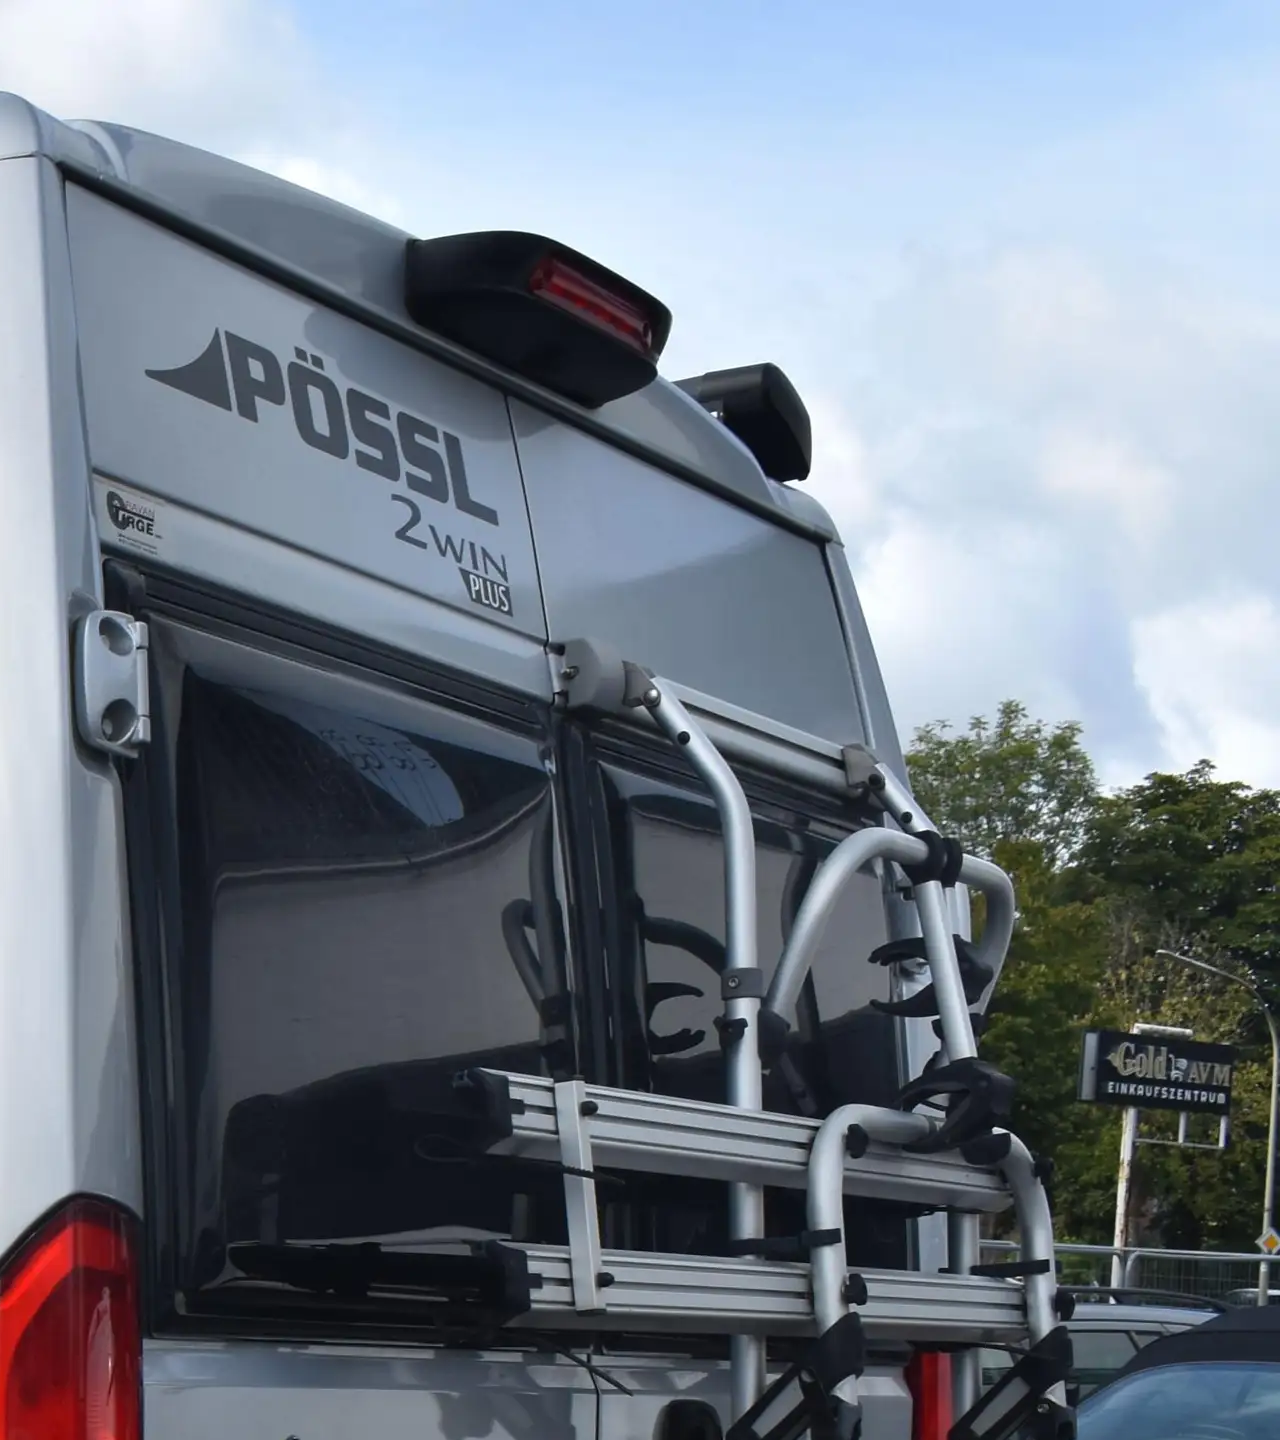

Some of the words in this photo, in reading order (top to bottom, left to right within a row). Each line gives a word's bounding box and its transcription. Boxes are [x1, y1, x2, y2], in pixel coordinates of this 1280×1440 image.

[223, 329, 499, 527] PÖSSL
[469, 574, 510, 612] PLUS
[1107, 1041, 1168, 1080] Gold
[1107, 1081, 1227, 1104] EINKAUFSZENTRUM
